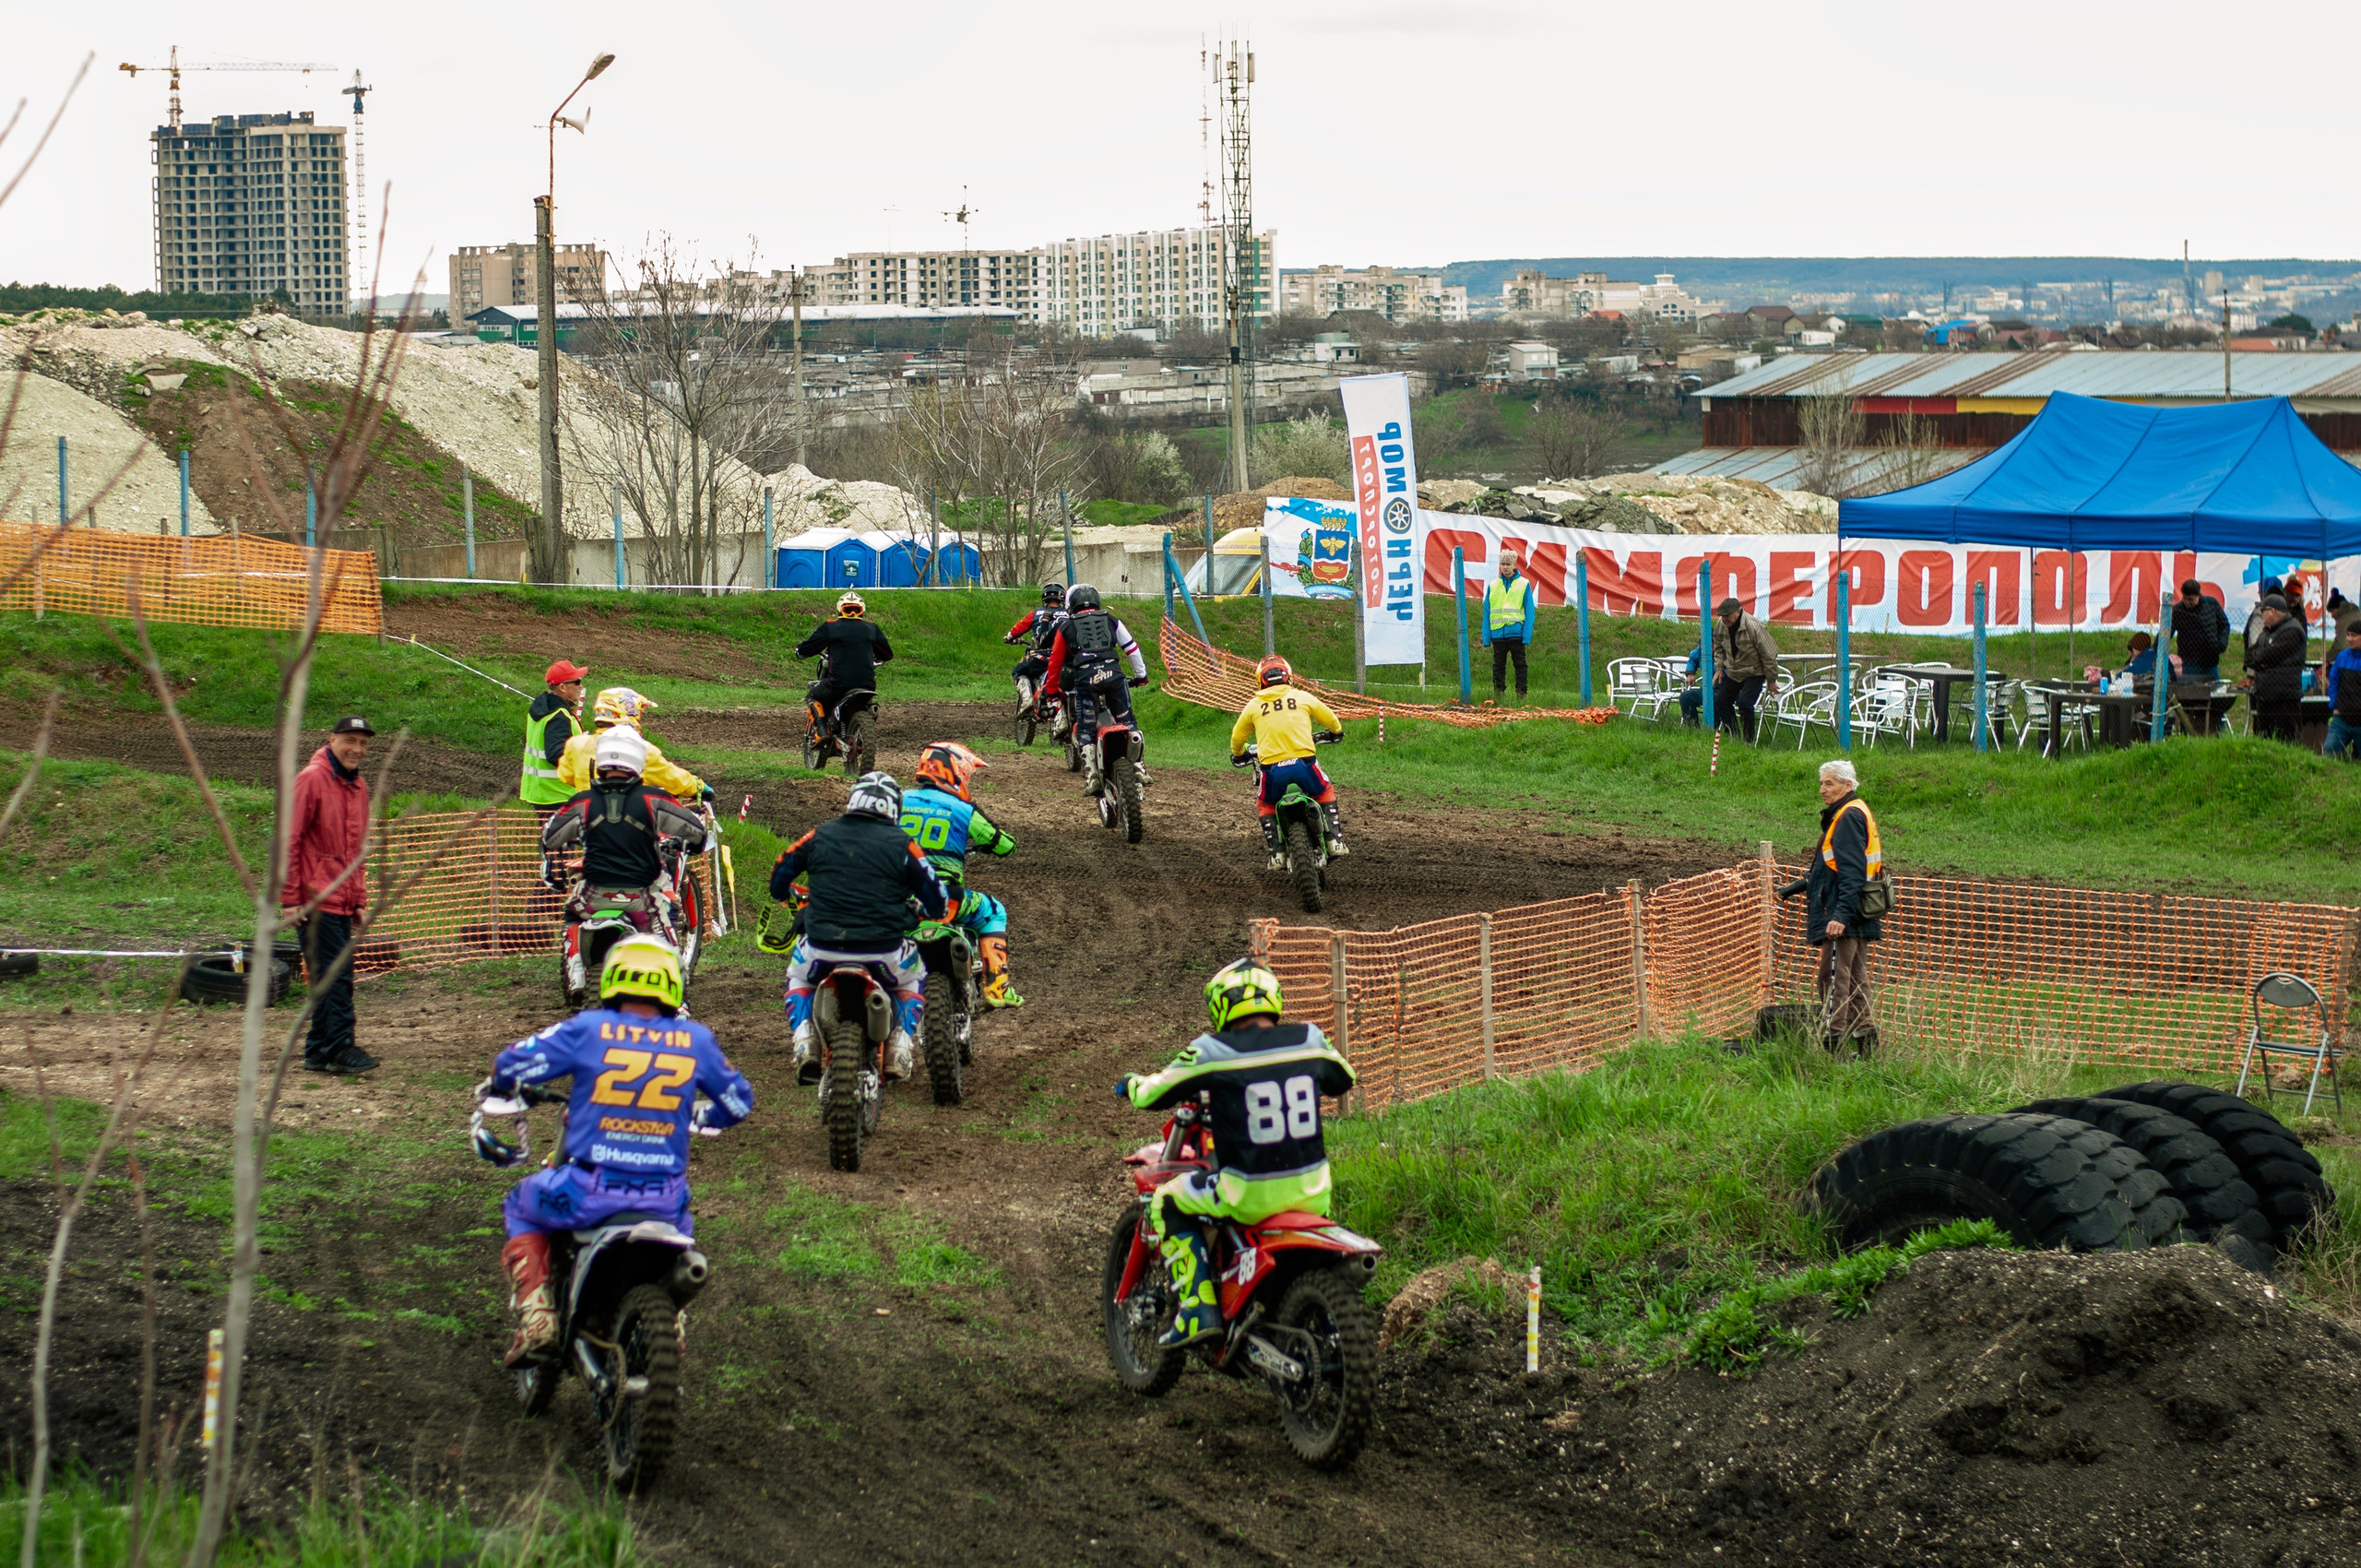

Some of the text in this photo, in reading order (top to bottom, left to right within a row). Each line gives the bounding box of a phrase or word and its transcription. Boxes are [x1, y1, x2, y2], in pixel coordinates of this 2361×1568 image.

[1260, 698, 1298, 717] 288
[899, 814, 951, 850] 20
[600, 1022, 692, 1048] LITVIN
[590, 1047, 697, 1111] 22
[1245, 1075, 1316, 1144] 88
[599, 1116, 676, 1136] ROCKSTAR
[606, 1132, 640, 1141] ENERGY
[607, 1147, 675, 1166] Husqvarna
[1238, 1247, 1256, 1286] 88
